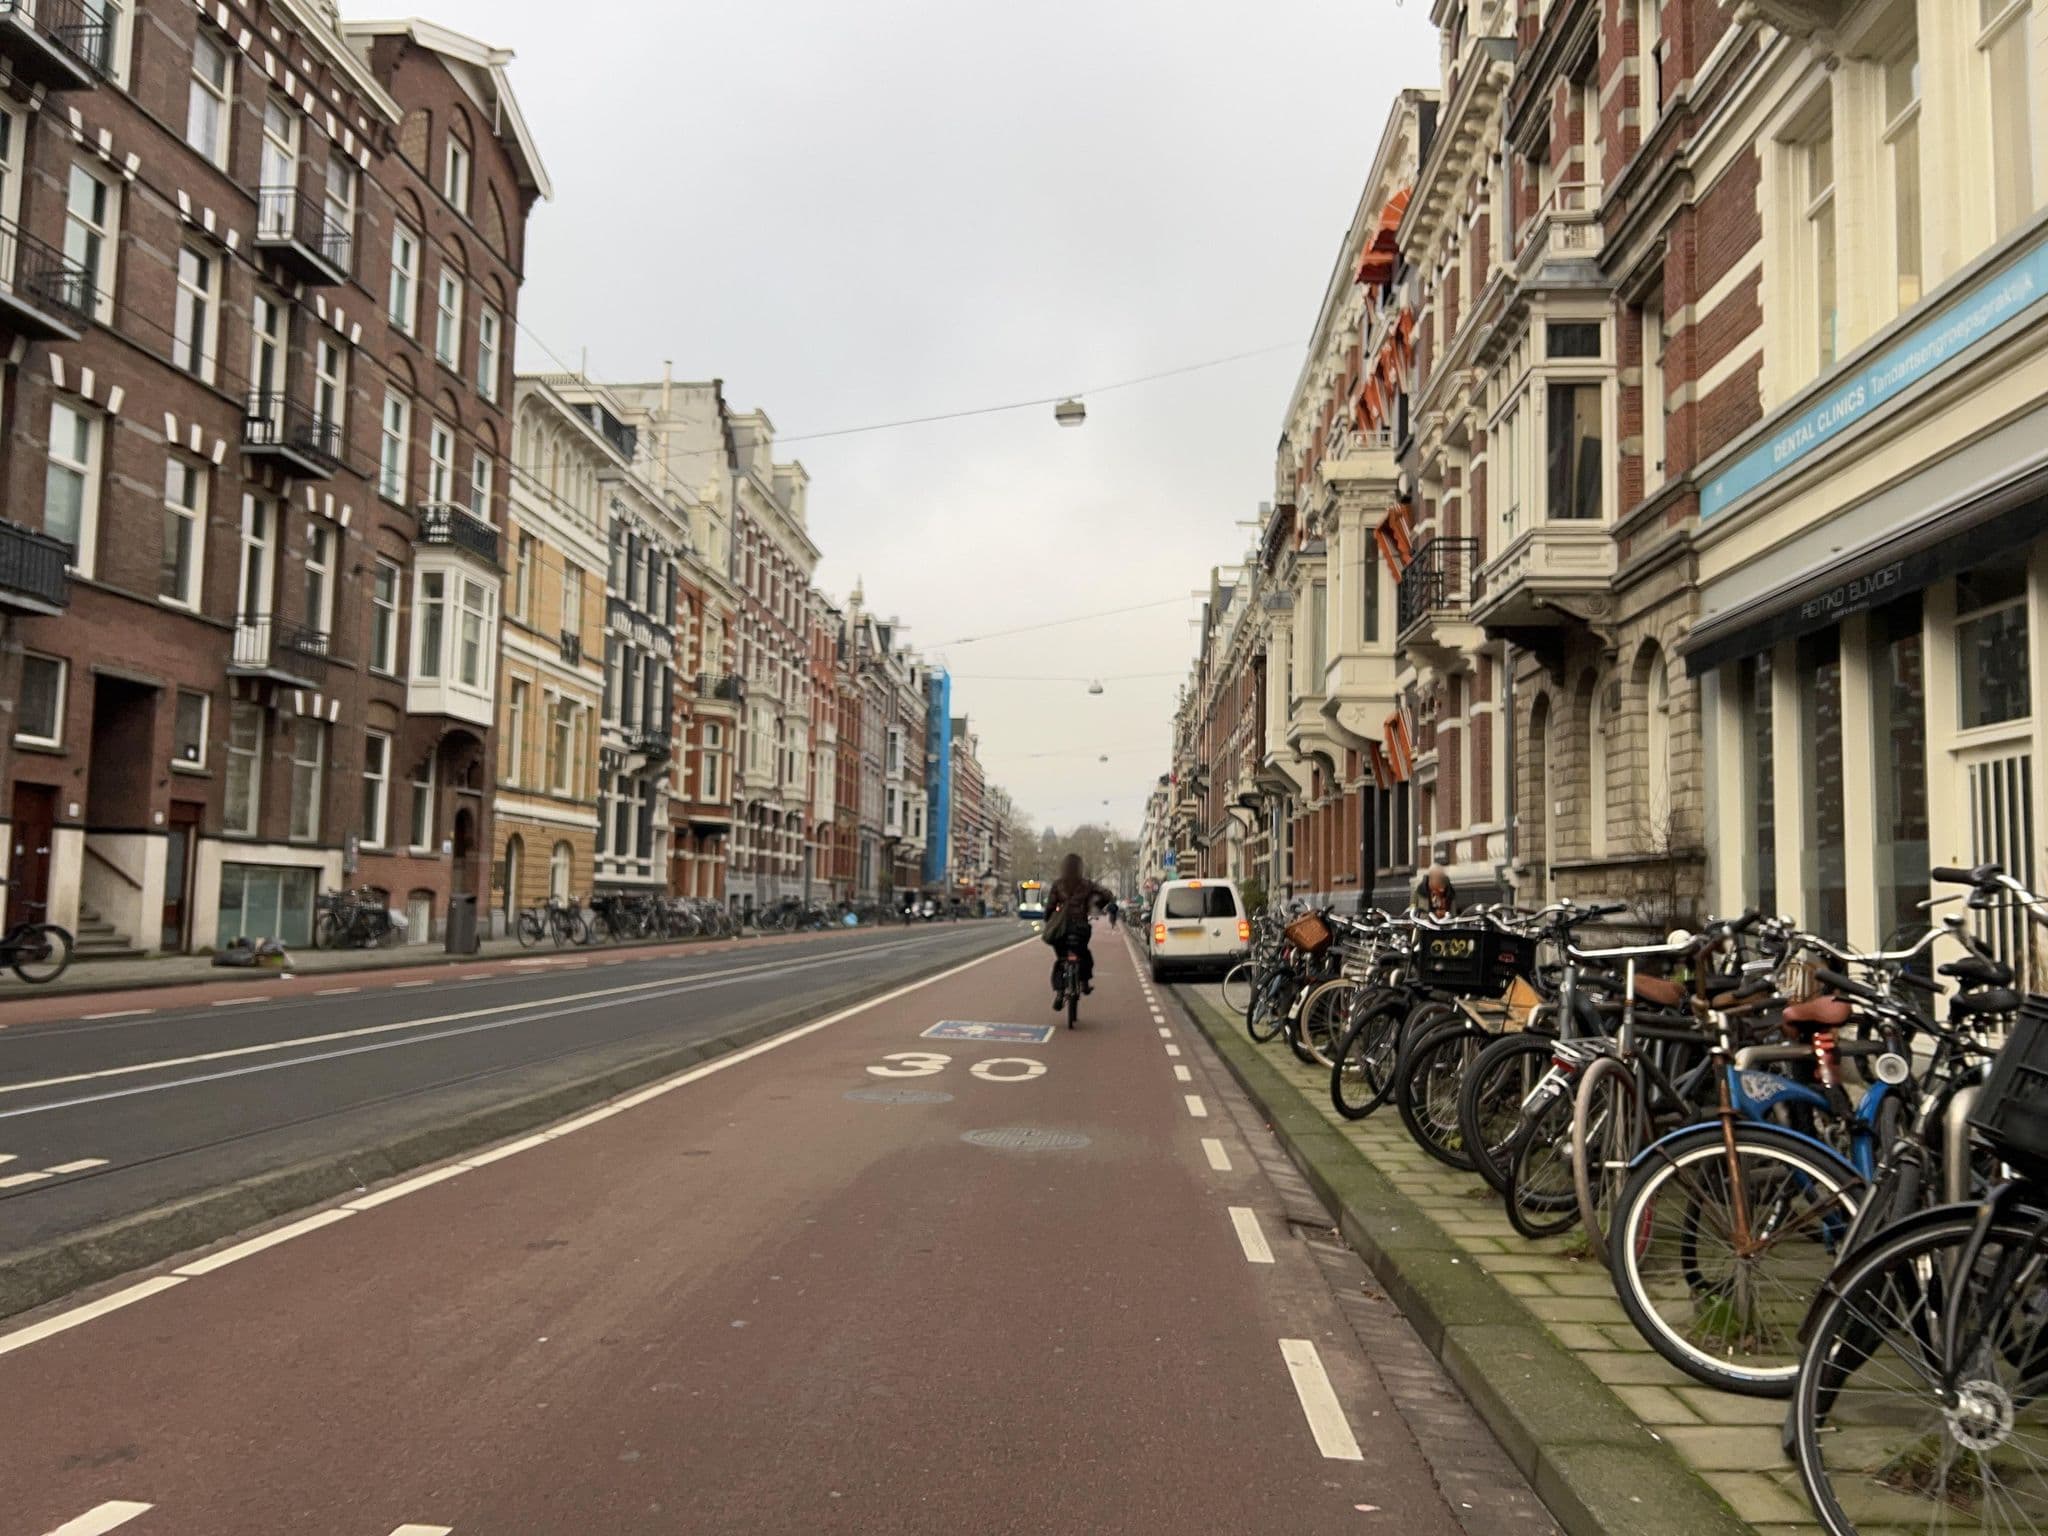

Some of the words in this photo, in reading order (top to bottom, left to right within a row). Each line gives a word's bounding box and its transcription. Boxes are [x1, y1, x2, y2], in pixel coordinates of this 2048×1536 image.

[1774, 424, 1815, 462] DENTAL
[1817, 384, 1864, 433] CLINICS
[866, 1052, 1048, 1082] 30
